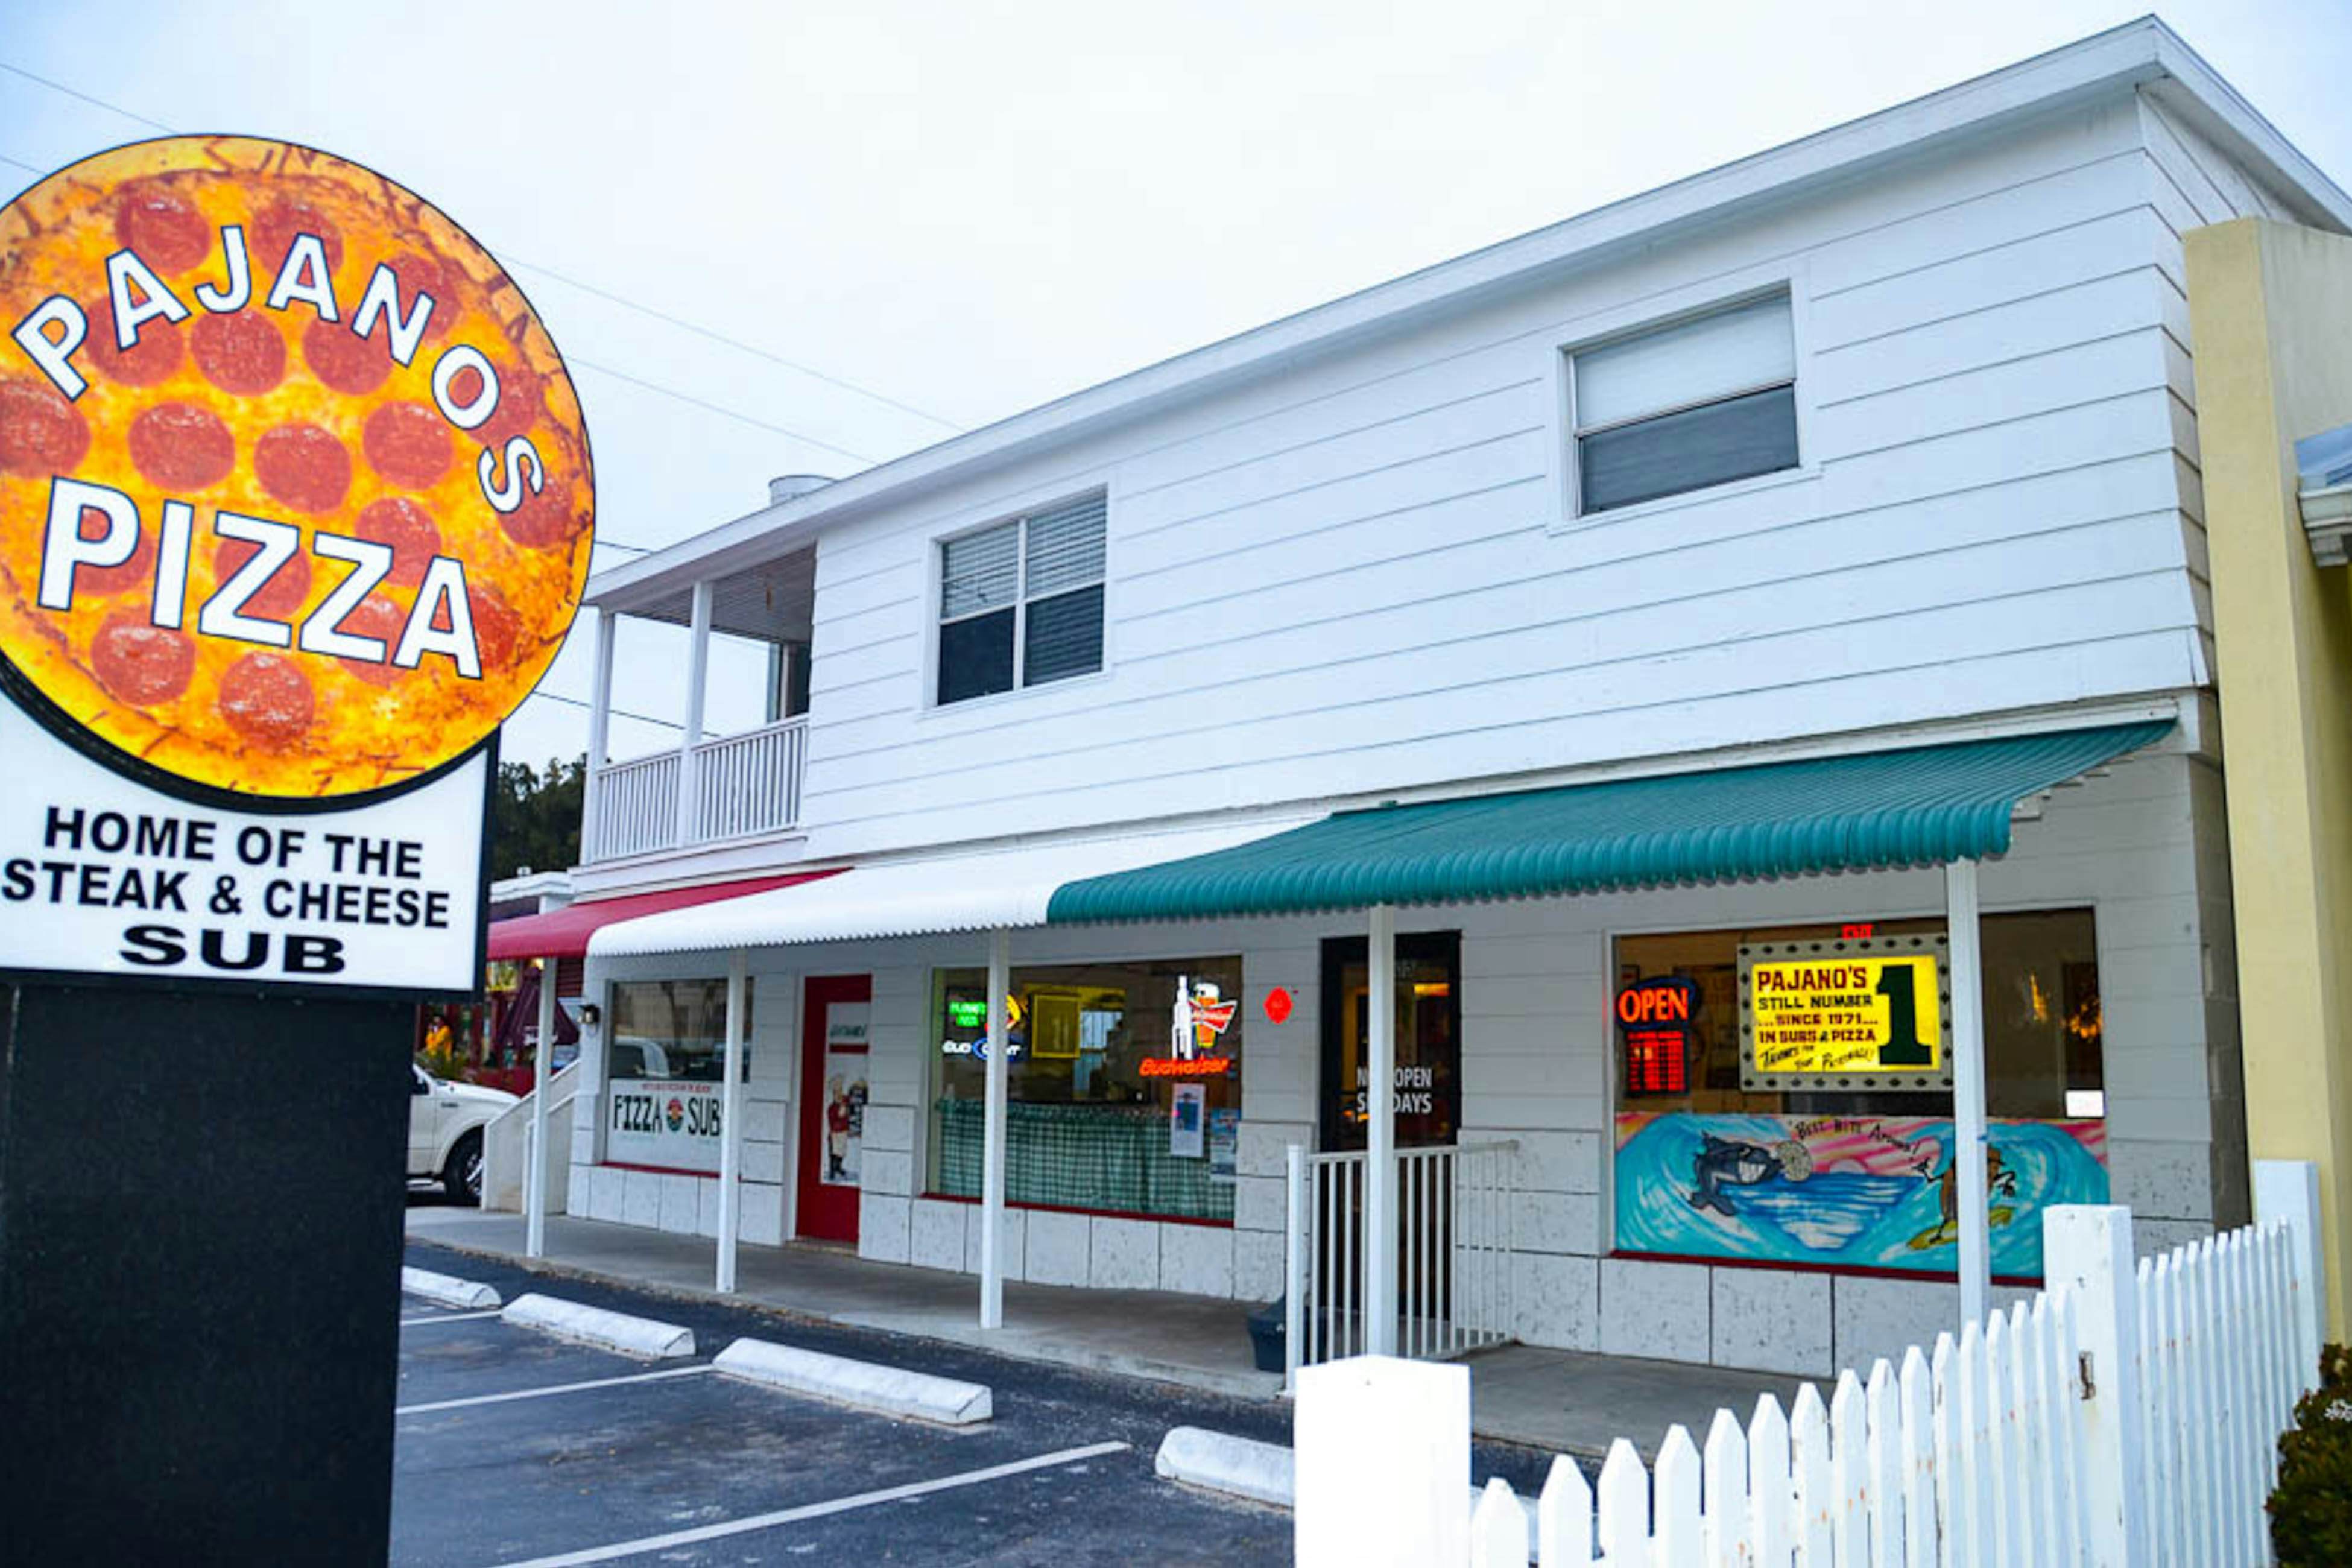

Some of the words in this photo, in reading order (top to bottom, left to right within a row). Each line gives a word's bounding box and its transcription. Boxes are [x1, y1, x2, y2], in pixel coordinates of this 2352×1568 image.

[10, 225, 544, 513] PAJANOS
[37, 476, 483, 680] PIZZA
[43, 806, 217, 861] HOME
[237, 826, 306, 868] OF
[324, 833, 423, 879] THE
[2, 858, 189, 912] STEAK
[209, 874, 242, 915] &
[264, 878, 450, 928] CHEESE
[120, 924, 346, 975] SUB
[1757, 965, 1868, 991] PAJANO'S
[1758, 996, 1804, 1011] STILL
[1810, 994, 1873, 1009] NUMBER
[1618, 987, 1689, 1023] OPEN
[1876, 964, 1933, 1066] 1
[1759, 1030, 1777, 1044] IN
[1831, 1028, 1877, 1042] PIZZA
[1394, 1066, 1432, 1088] OPEN
